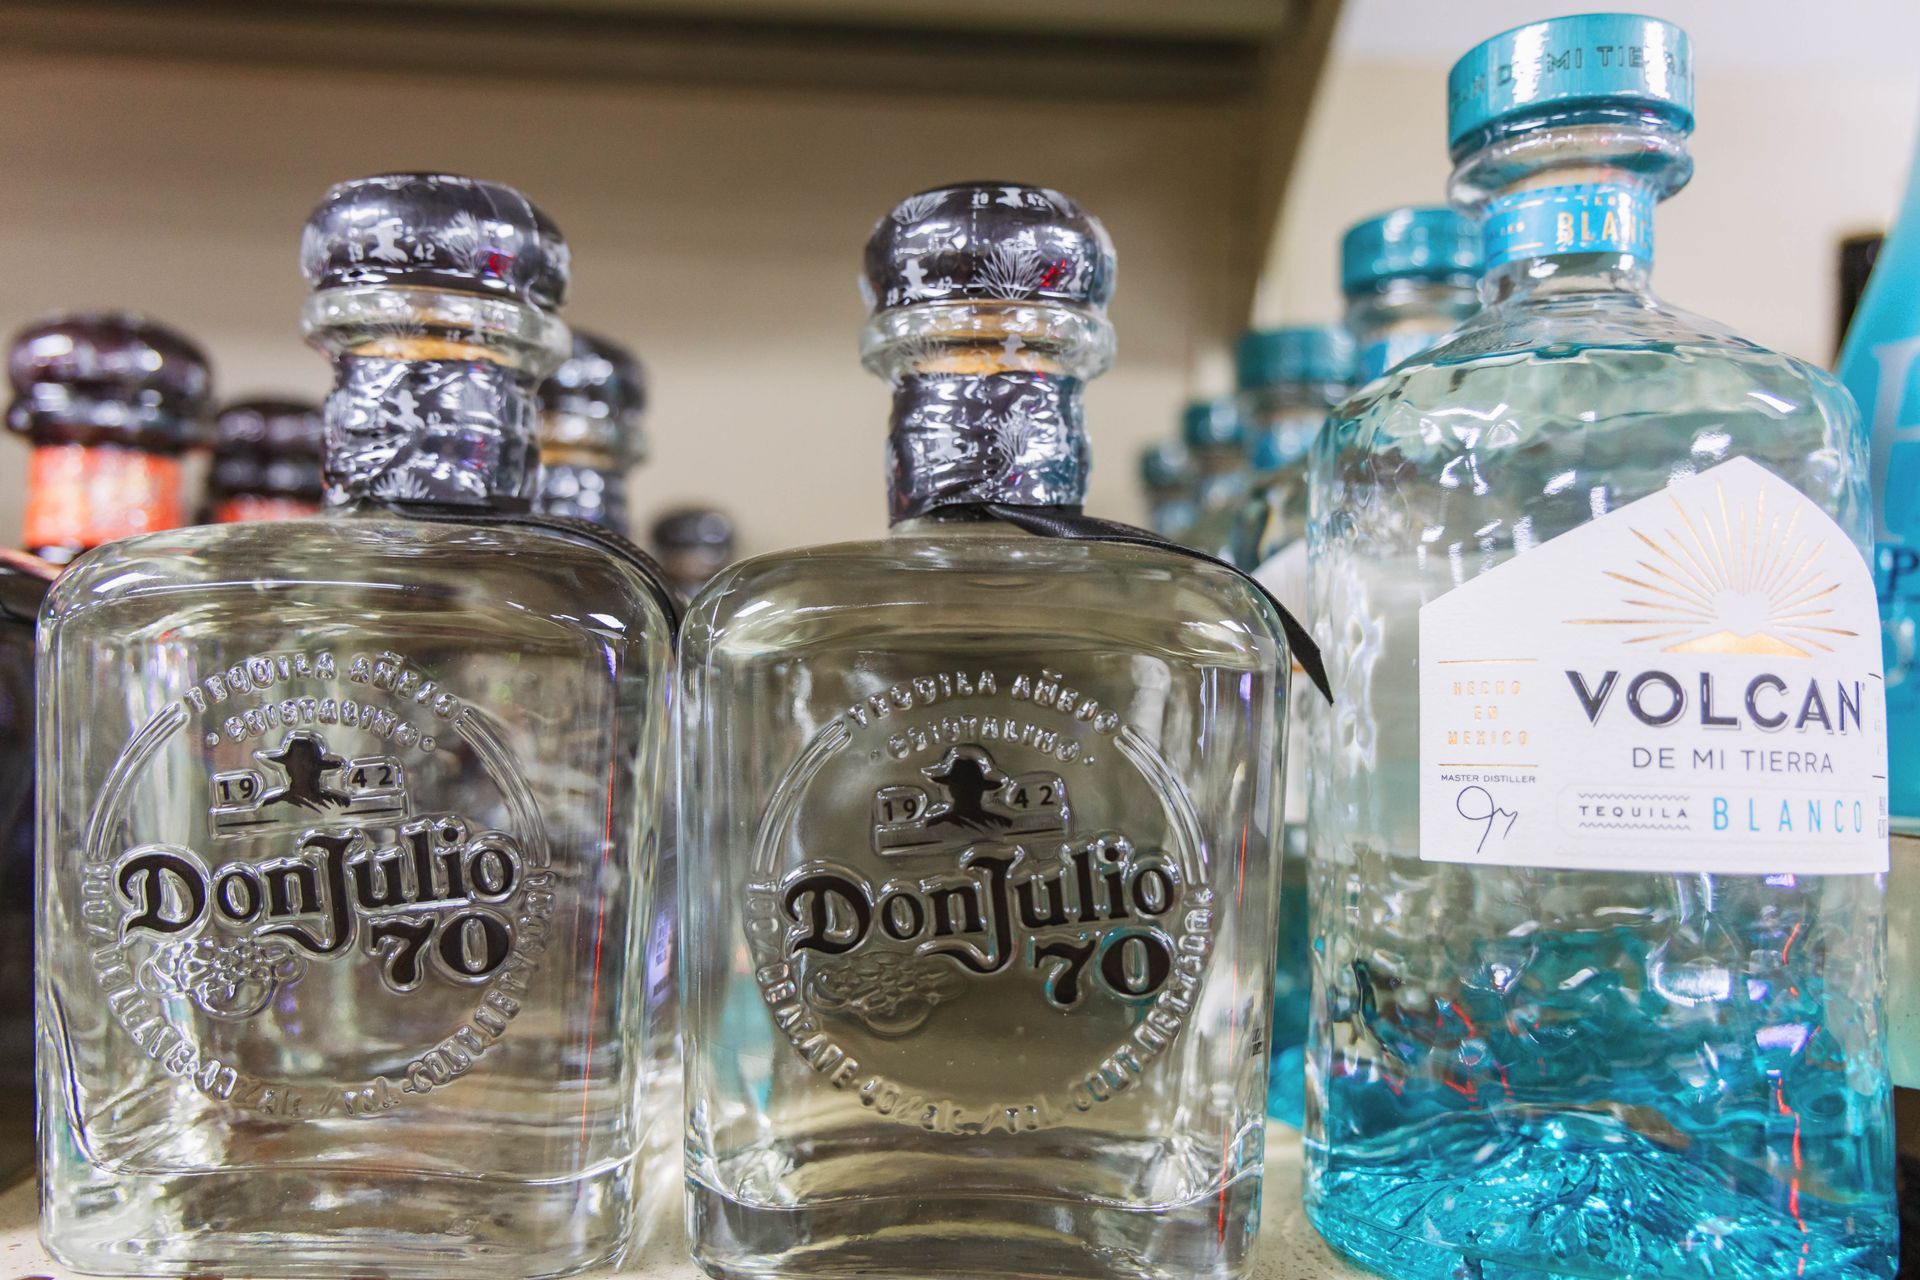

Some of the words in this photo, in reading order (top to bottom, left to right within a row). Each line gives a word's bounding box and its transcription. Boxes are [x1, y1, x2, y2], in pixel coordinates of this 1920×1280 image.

[414, 243, 436, 261] 42
[185, 651, 336, 713] TEQUILA
[849, 669, 997, 729] TEQUILA
[224, 695, 420, 747] CRISTALINO
[1474, 705, 1498, 720] EN
[887, 714, 1080, 763] CRISTALINO
[1448, 730, 1530, 746] MEXICO
[1632, 747, 1675, 769] DE
[1693, 748, 1725, 770] MI
[1741, 749, 1834, 774] TIERRA
[219, 777, 255, 800] 19
[351, 765, 394, 788] 42
[1441, 774, 1479, 783] MASTER
[1483, 775, 1537, 784] DISTILLER
[883, 798, 917, 821] 19
[1013, 785, 1054, 809] 42
[1578, 805, 1688, 818] TEQUILA
[1713, 796, 1862, 833] BLANCO
[370, 914, 510, 985] 70
[1034, 934, 1171, 1005] 70
